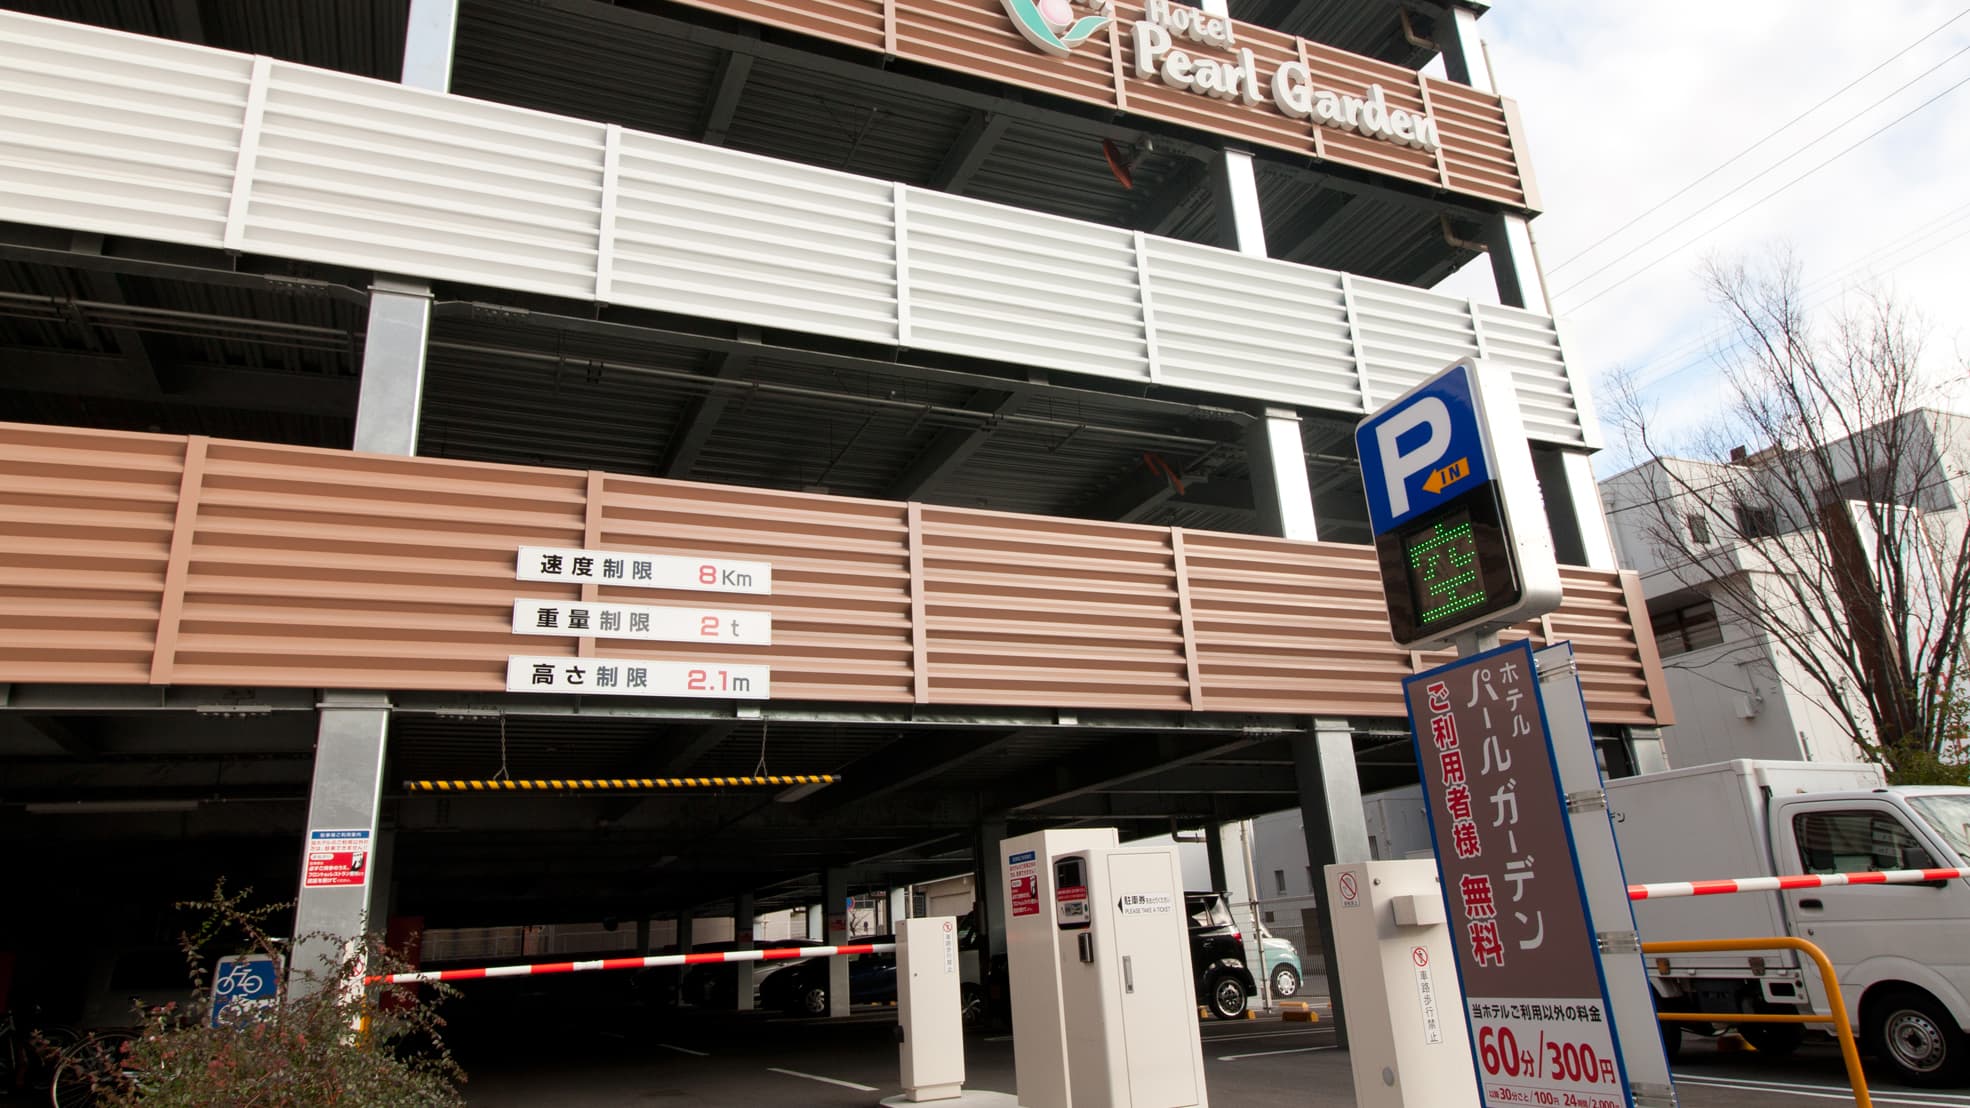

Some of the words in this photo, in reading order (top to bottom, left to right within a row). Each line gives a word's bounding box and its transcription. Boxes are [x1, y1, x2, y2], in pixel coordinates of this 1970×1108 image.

[1146, 0, 1235, 48] Hotel
[1132, 20, 1263, 106] Pearl
[1272, 60, 1440, 153] Garden
[1375, 396, 1452, 519] P
[1440, 463, 1461, 485] IN
[540, 554, 653, 580] 速度制限
[536, 607, 650, 632] 重量制限
[531, 663, 648, 688] 高さ制限
[687, 669, 751, 692] 2.1m
[1499, 662, 1531, 738] ホテル
[1426, 680, 1482, 860] ご利用者様
[1458, 873, 1505, 967] 無料
[1467, 667, 1544, 951] パールガーデン
[1472, 1004, 1602, 1023] 当ホテルご利用以外の料金
[1478, 1025, 1616, 1085] 60分/300円
